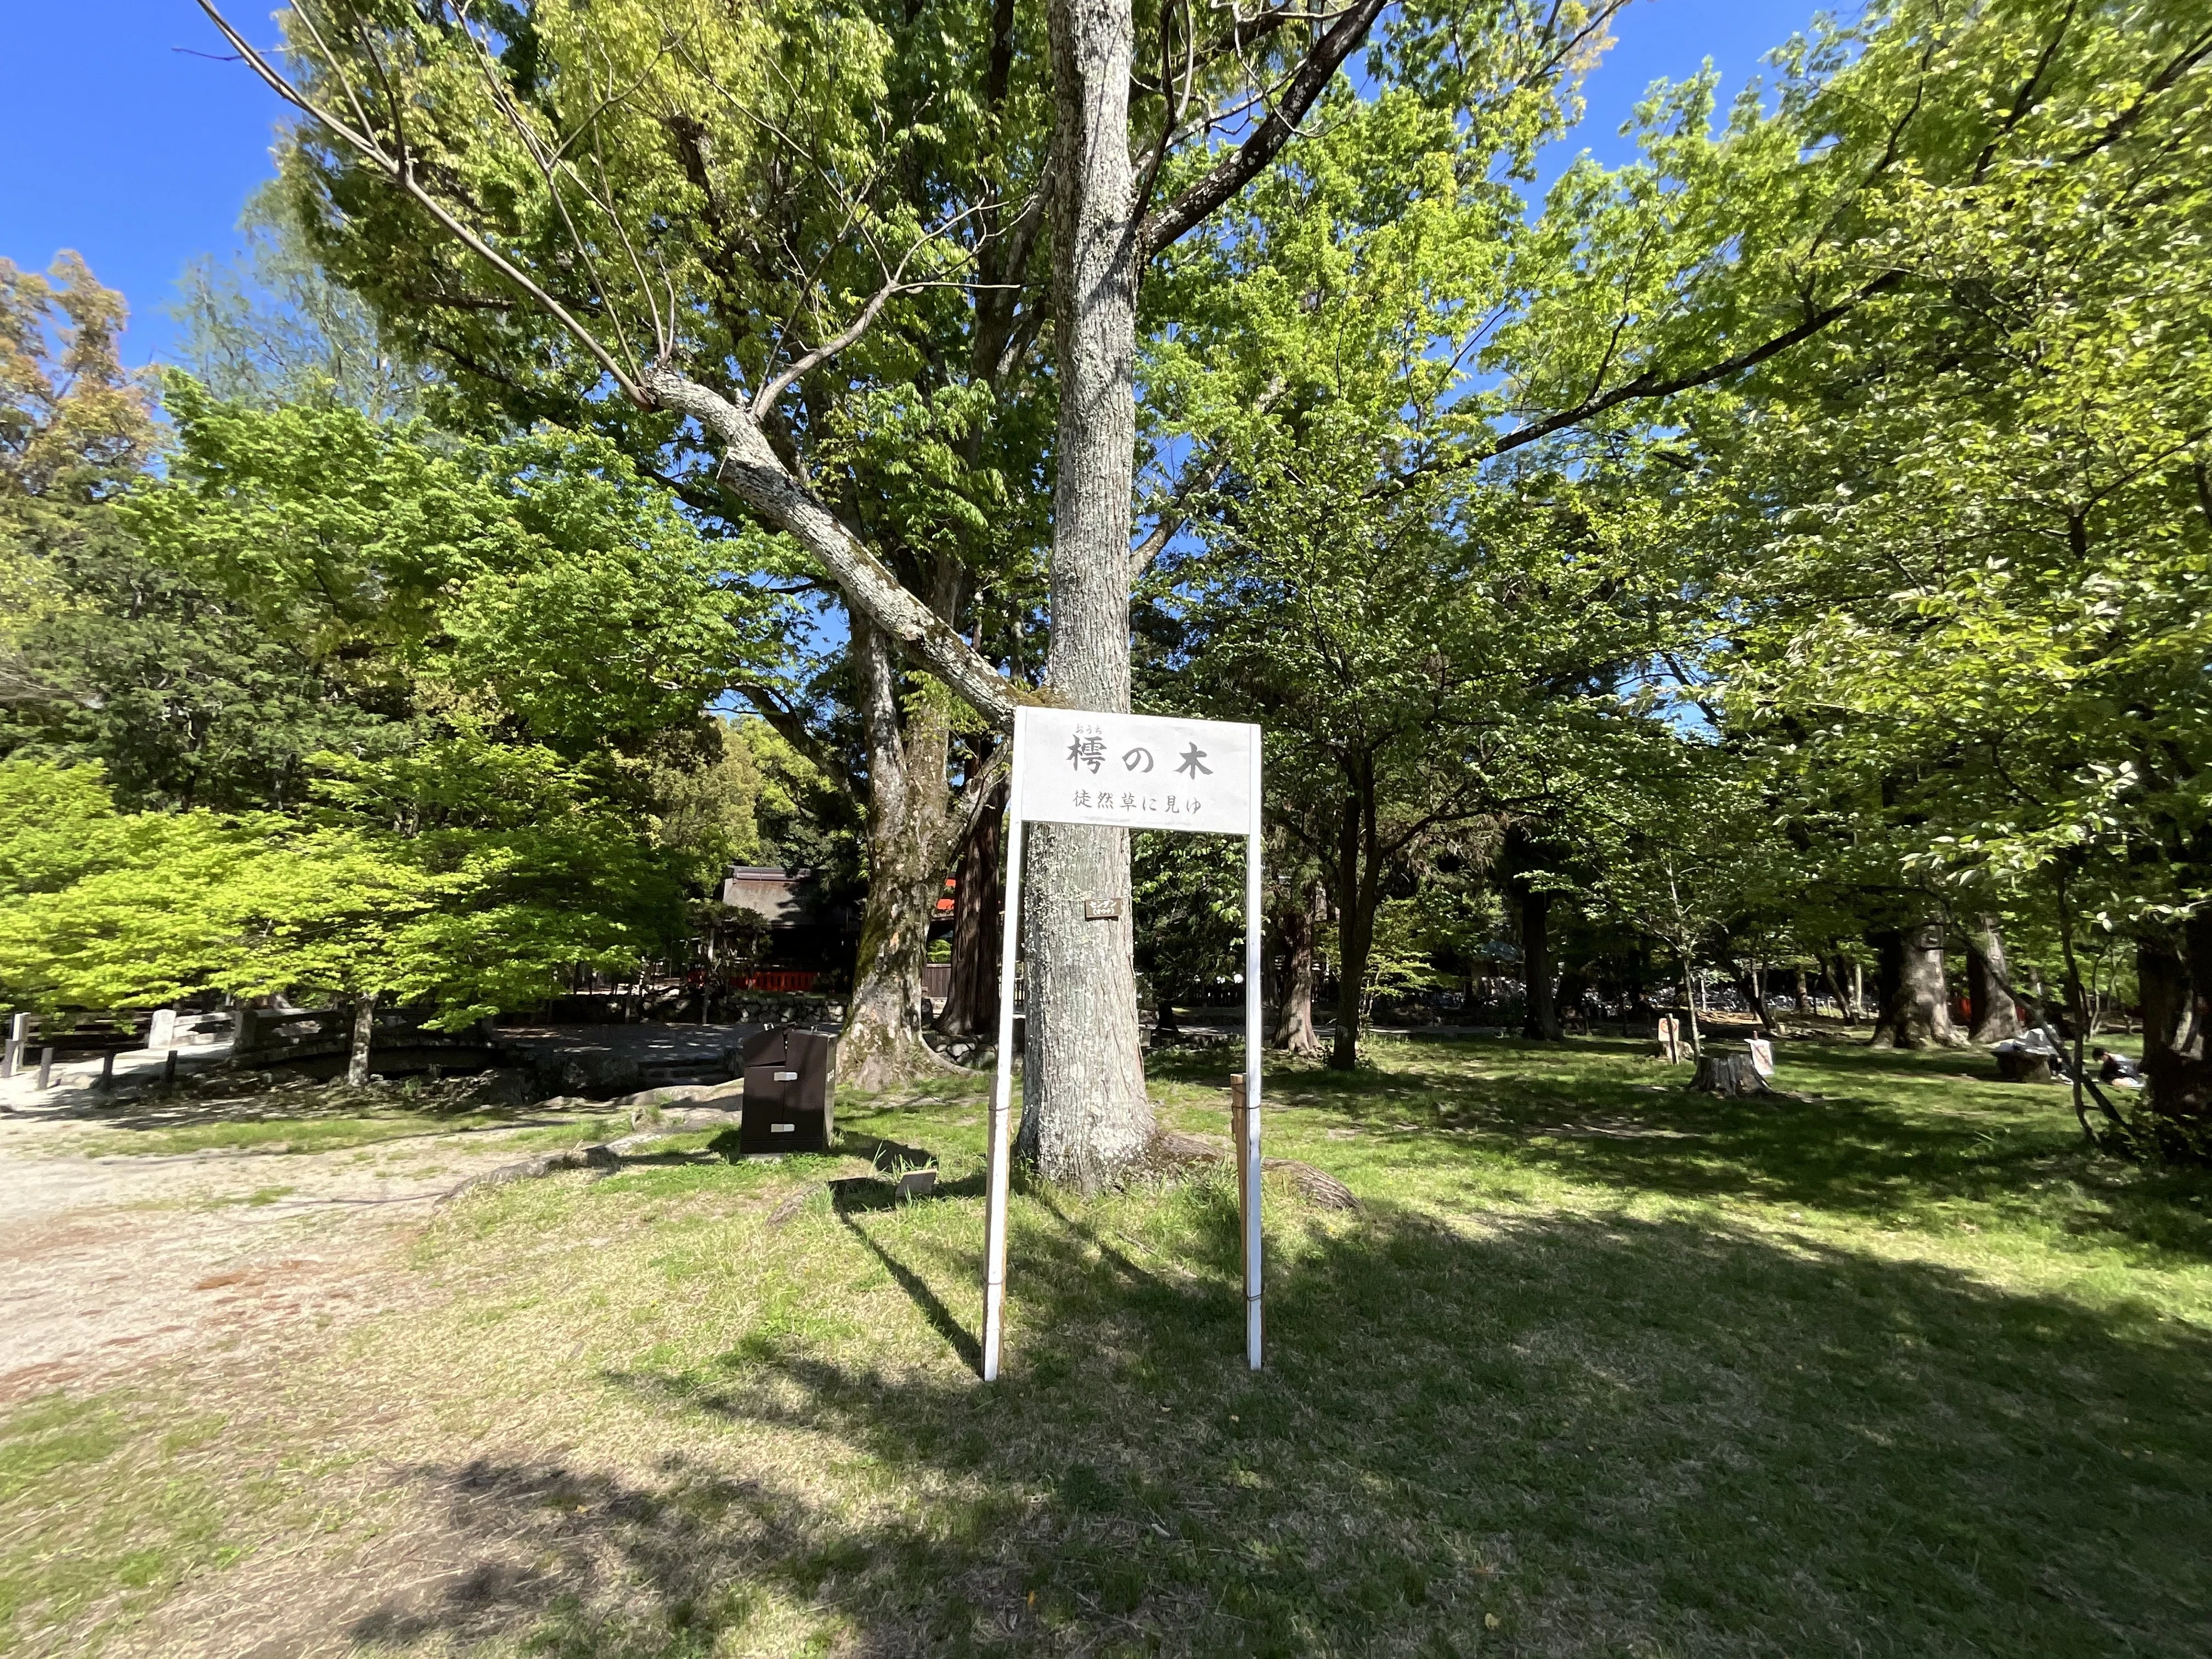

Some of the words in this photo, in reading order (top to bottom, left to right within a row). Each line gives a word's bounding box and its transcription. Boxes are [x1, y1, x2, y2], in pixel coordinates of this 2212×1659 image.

[1075, 724, 1102, 735] おうち
[1073, 789, 1201, 814] 徒然草に見ゆ
